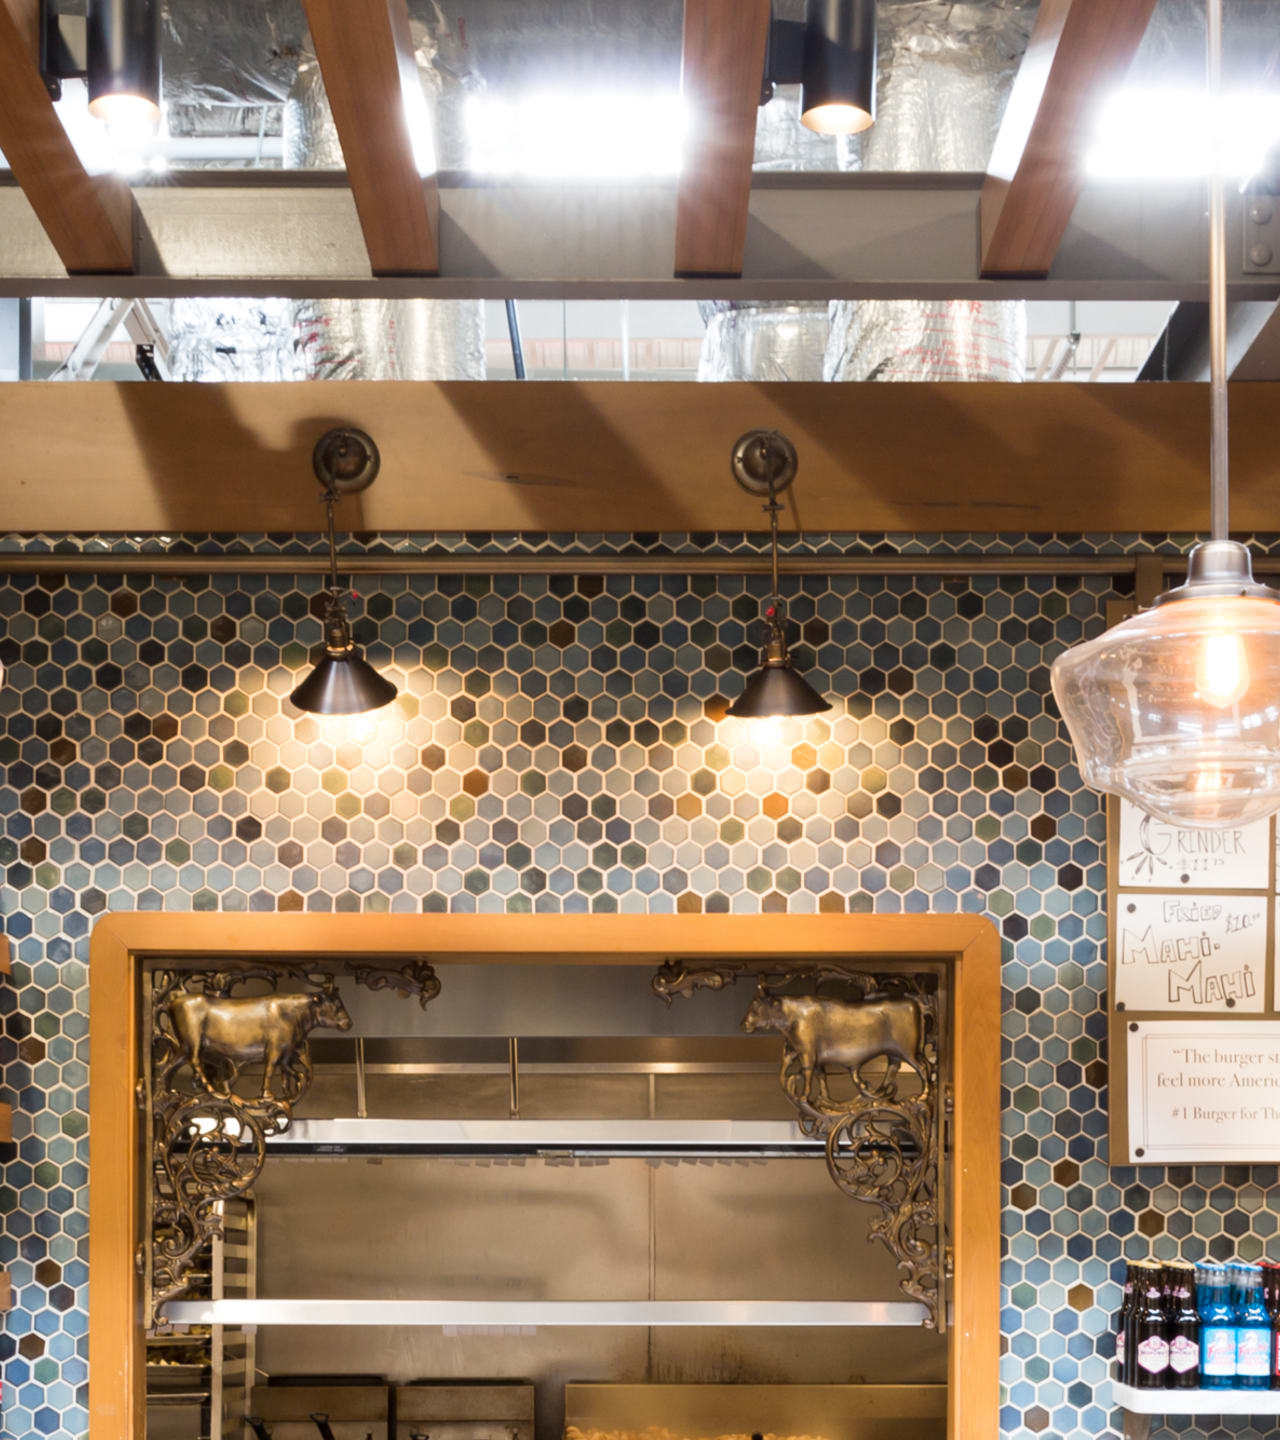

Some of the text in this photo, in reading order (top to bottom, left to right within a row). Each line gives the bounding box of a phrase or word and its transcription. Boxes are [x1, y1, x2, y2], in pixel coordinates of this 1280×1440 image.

[1214, 1049, 1264, 1069] burger
[1157, 1072, 1184, 1088] feel
[1188, 1076, 1226, 1088] more
[1193, 1106, 1237, 1124] Burger
[1240, 1106, 1258, 1120] for
